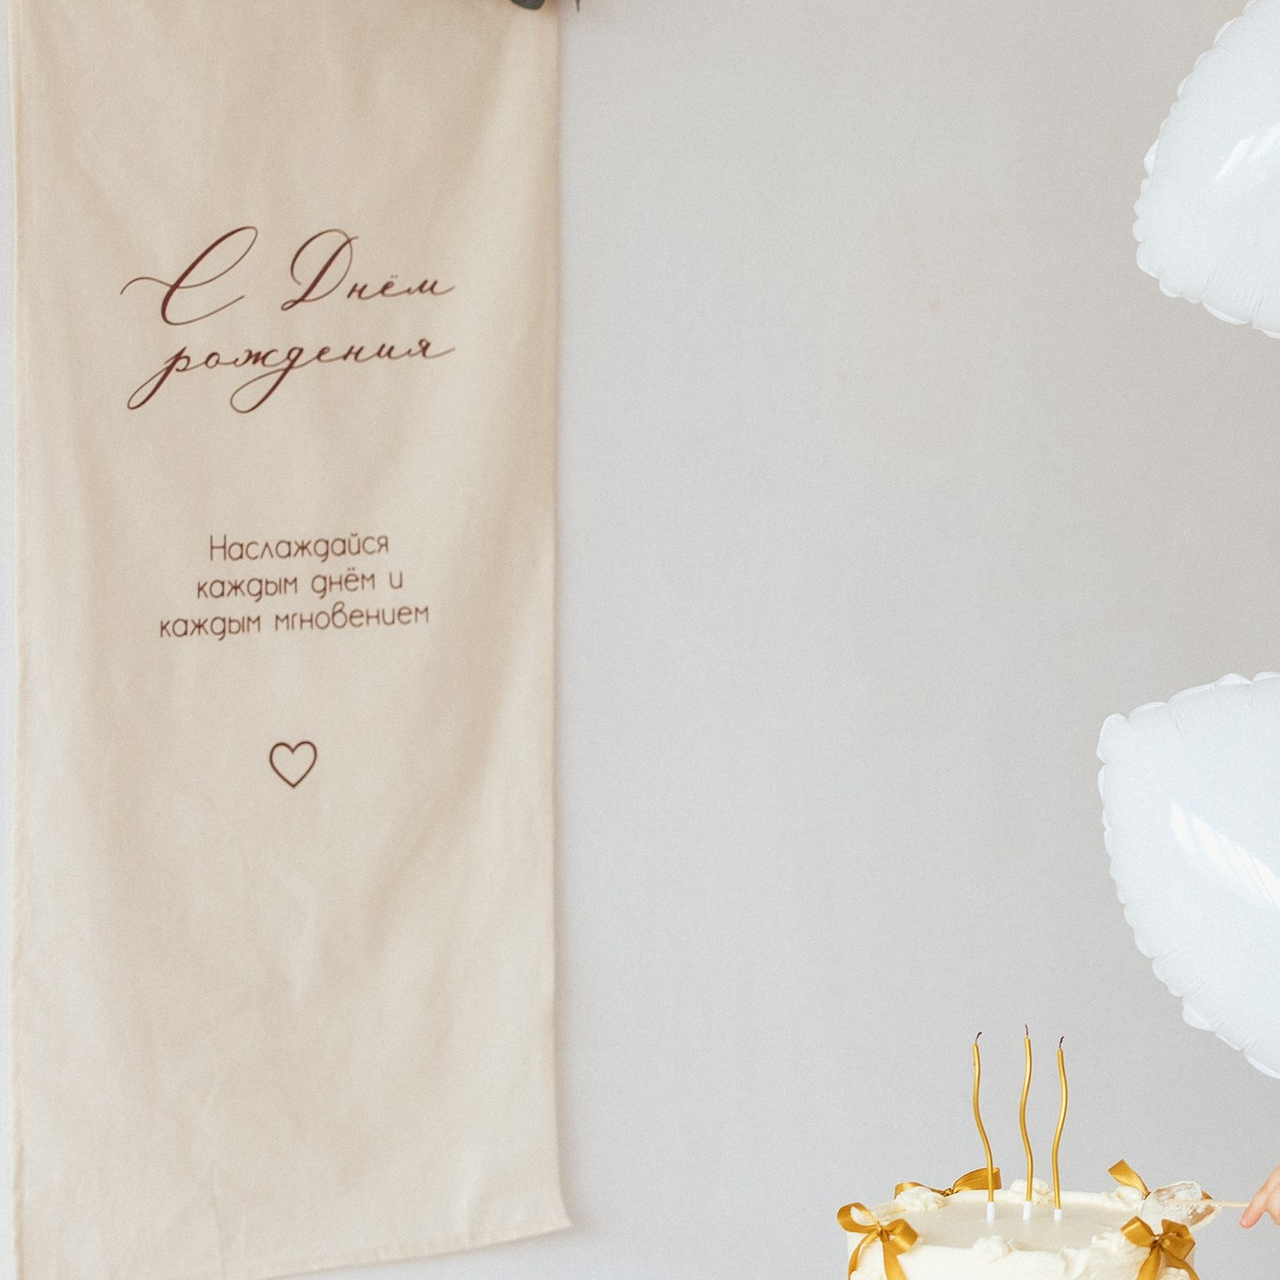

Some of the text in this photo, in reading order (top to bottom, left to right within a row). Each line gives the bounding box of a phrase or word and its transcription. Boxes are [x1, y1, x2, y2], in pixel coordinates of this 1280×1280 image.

[119, 225, 456, 327] С Днём
[126, 337, 456, 415] рождения
[209, 531, 390, 564] Наслаждайся
[196, 566, 404, 604] каждым днём и
[159, 600, 430, 643] каждым мгновением
